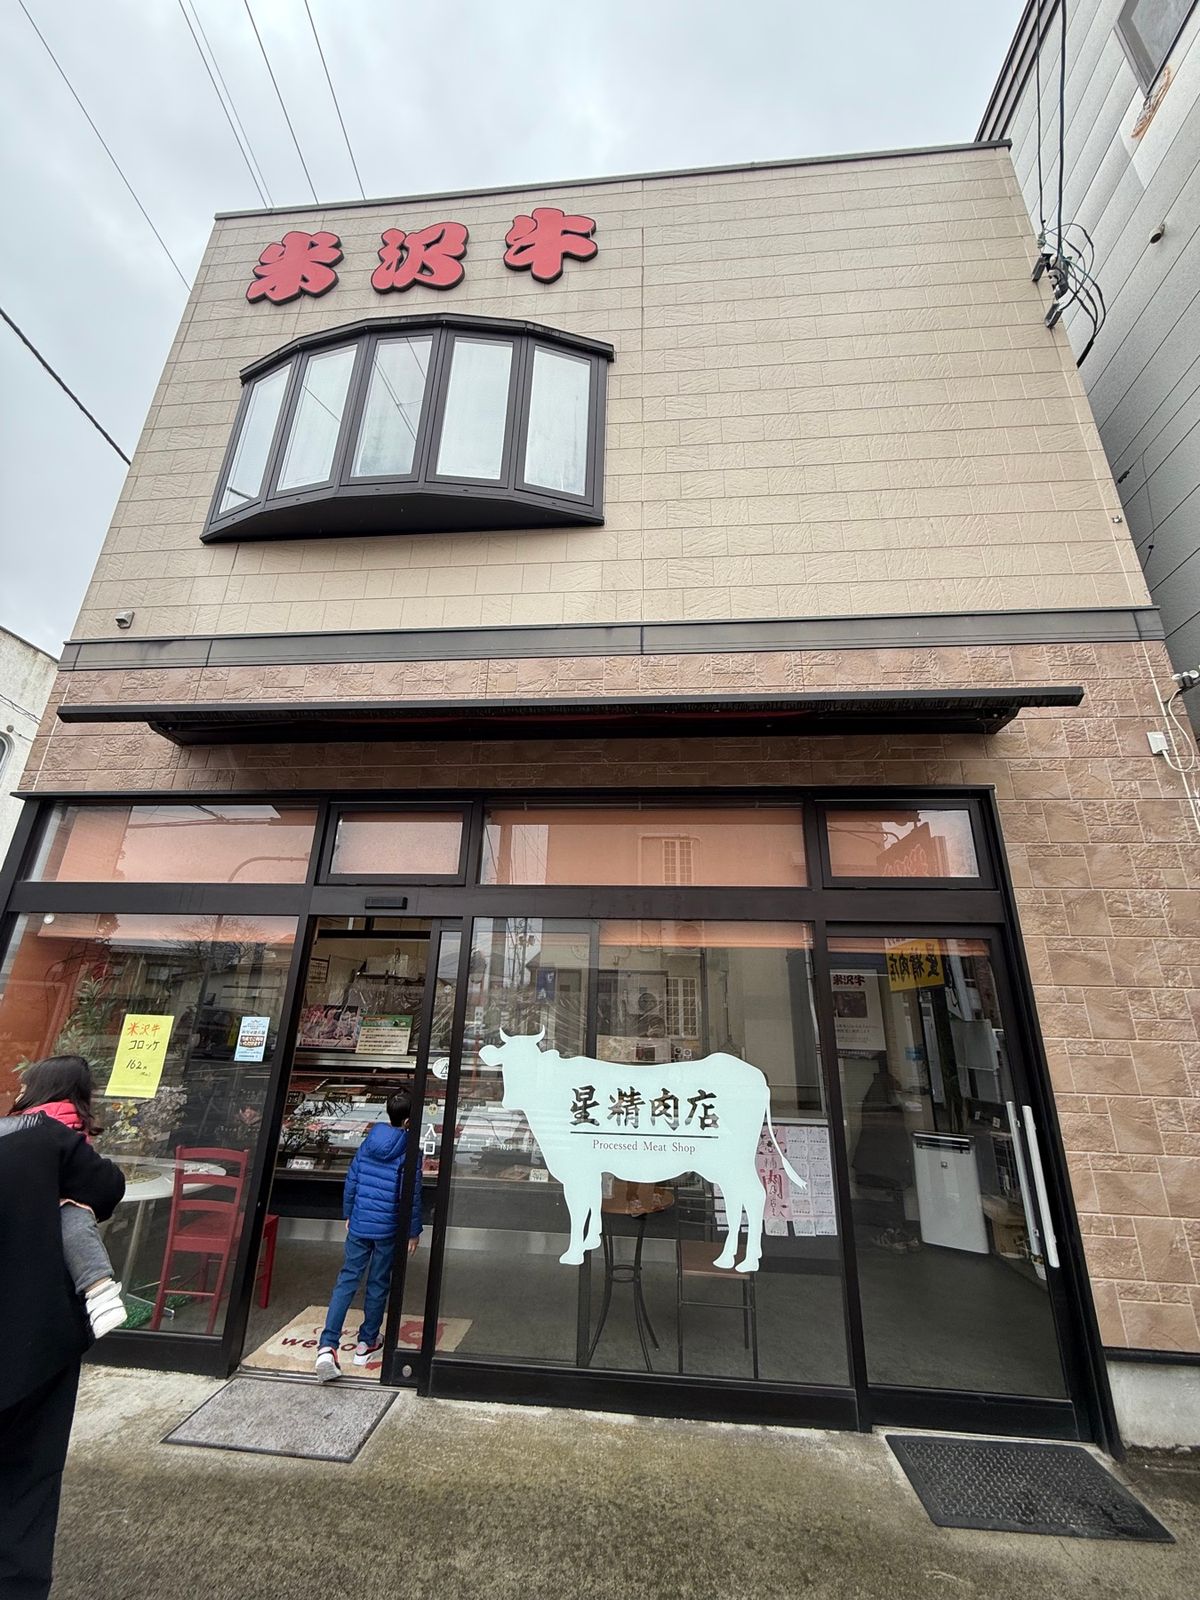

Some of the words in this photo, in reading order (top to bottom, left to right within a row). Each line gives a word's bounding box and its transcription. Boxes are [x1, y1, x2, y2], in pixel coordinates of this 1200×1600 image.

[246, 207, 598, 305] 米沢牛
[832, 974, 866, 986] 米沢牛
[127, 1021, 161, 1037] 米沢牛
[128, 1039, 161, 1051] コロッケ
[569, 1084, 720, 1131] 星精肉店
[423, 1123, 437, 1156] 入口
[592, 1139, 638, 1151] Processed
[643, 1141, 667, 1152] Meat
[672, 1141, 696, 1154] Shop
